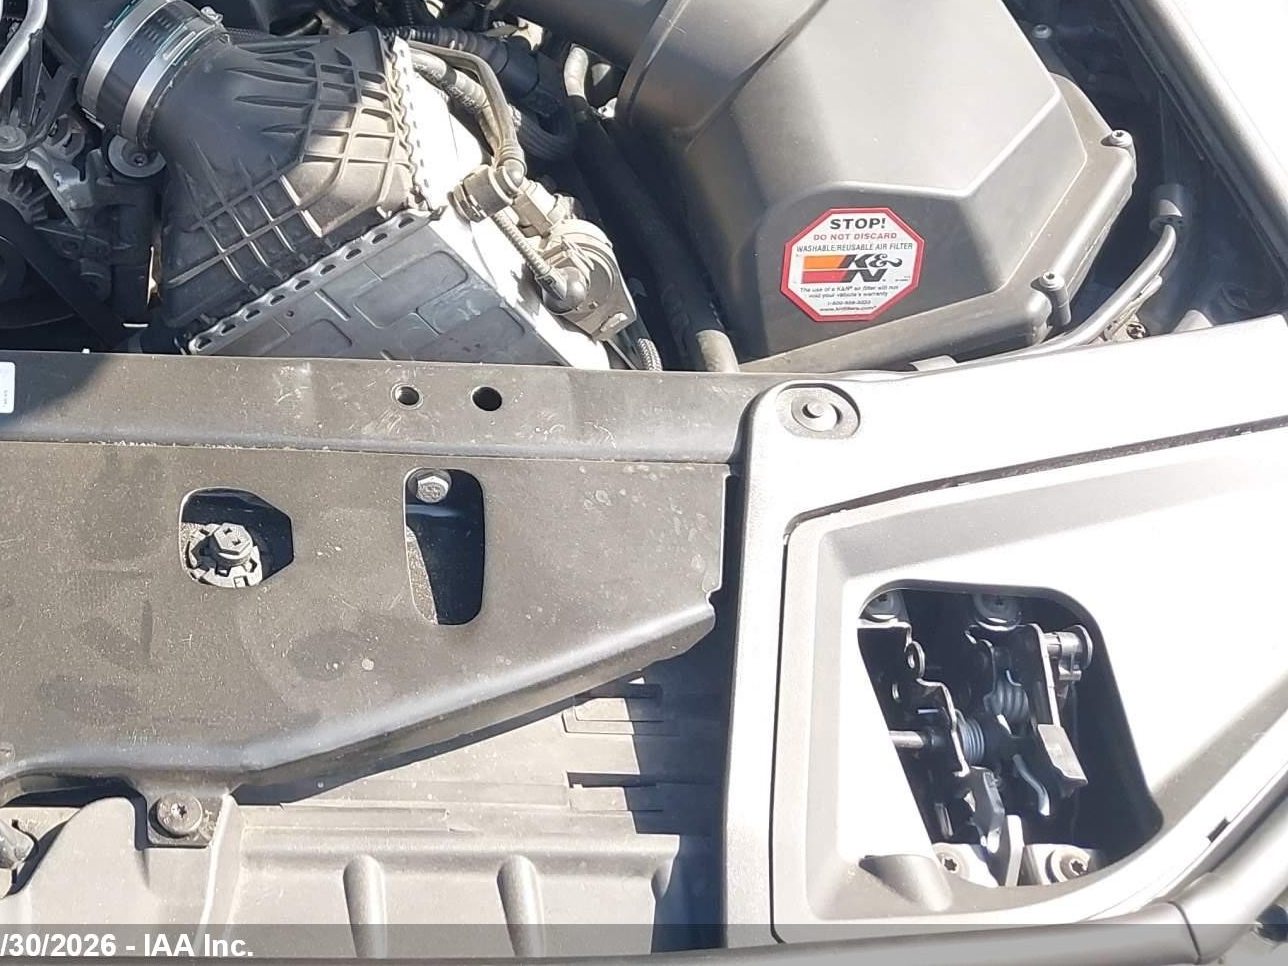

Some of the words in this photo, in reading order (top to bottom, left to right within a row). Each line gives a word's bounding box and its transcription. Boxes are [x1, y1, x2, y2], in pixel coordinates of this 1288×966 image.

[830, 218, 886, 230] STOP!
[853, 232, 897, 240] DISCARD
[797, 243, 873, 252] WASHABLE/REUSABLE
